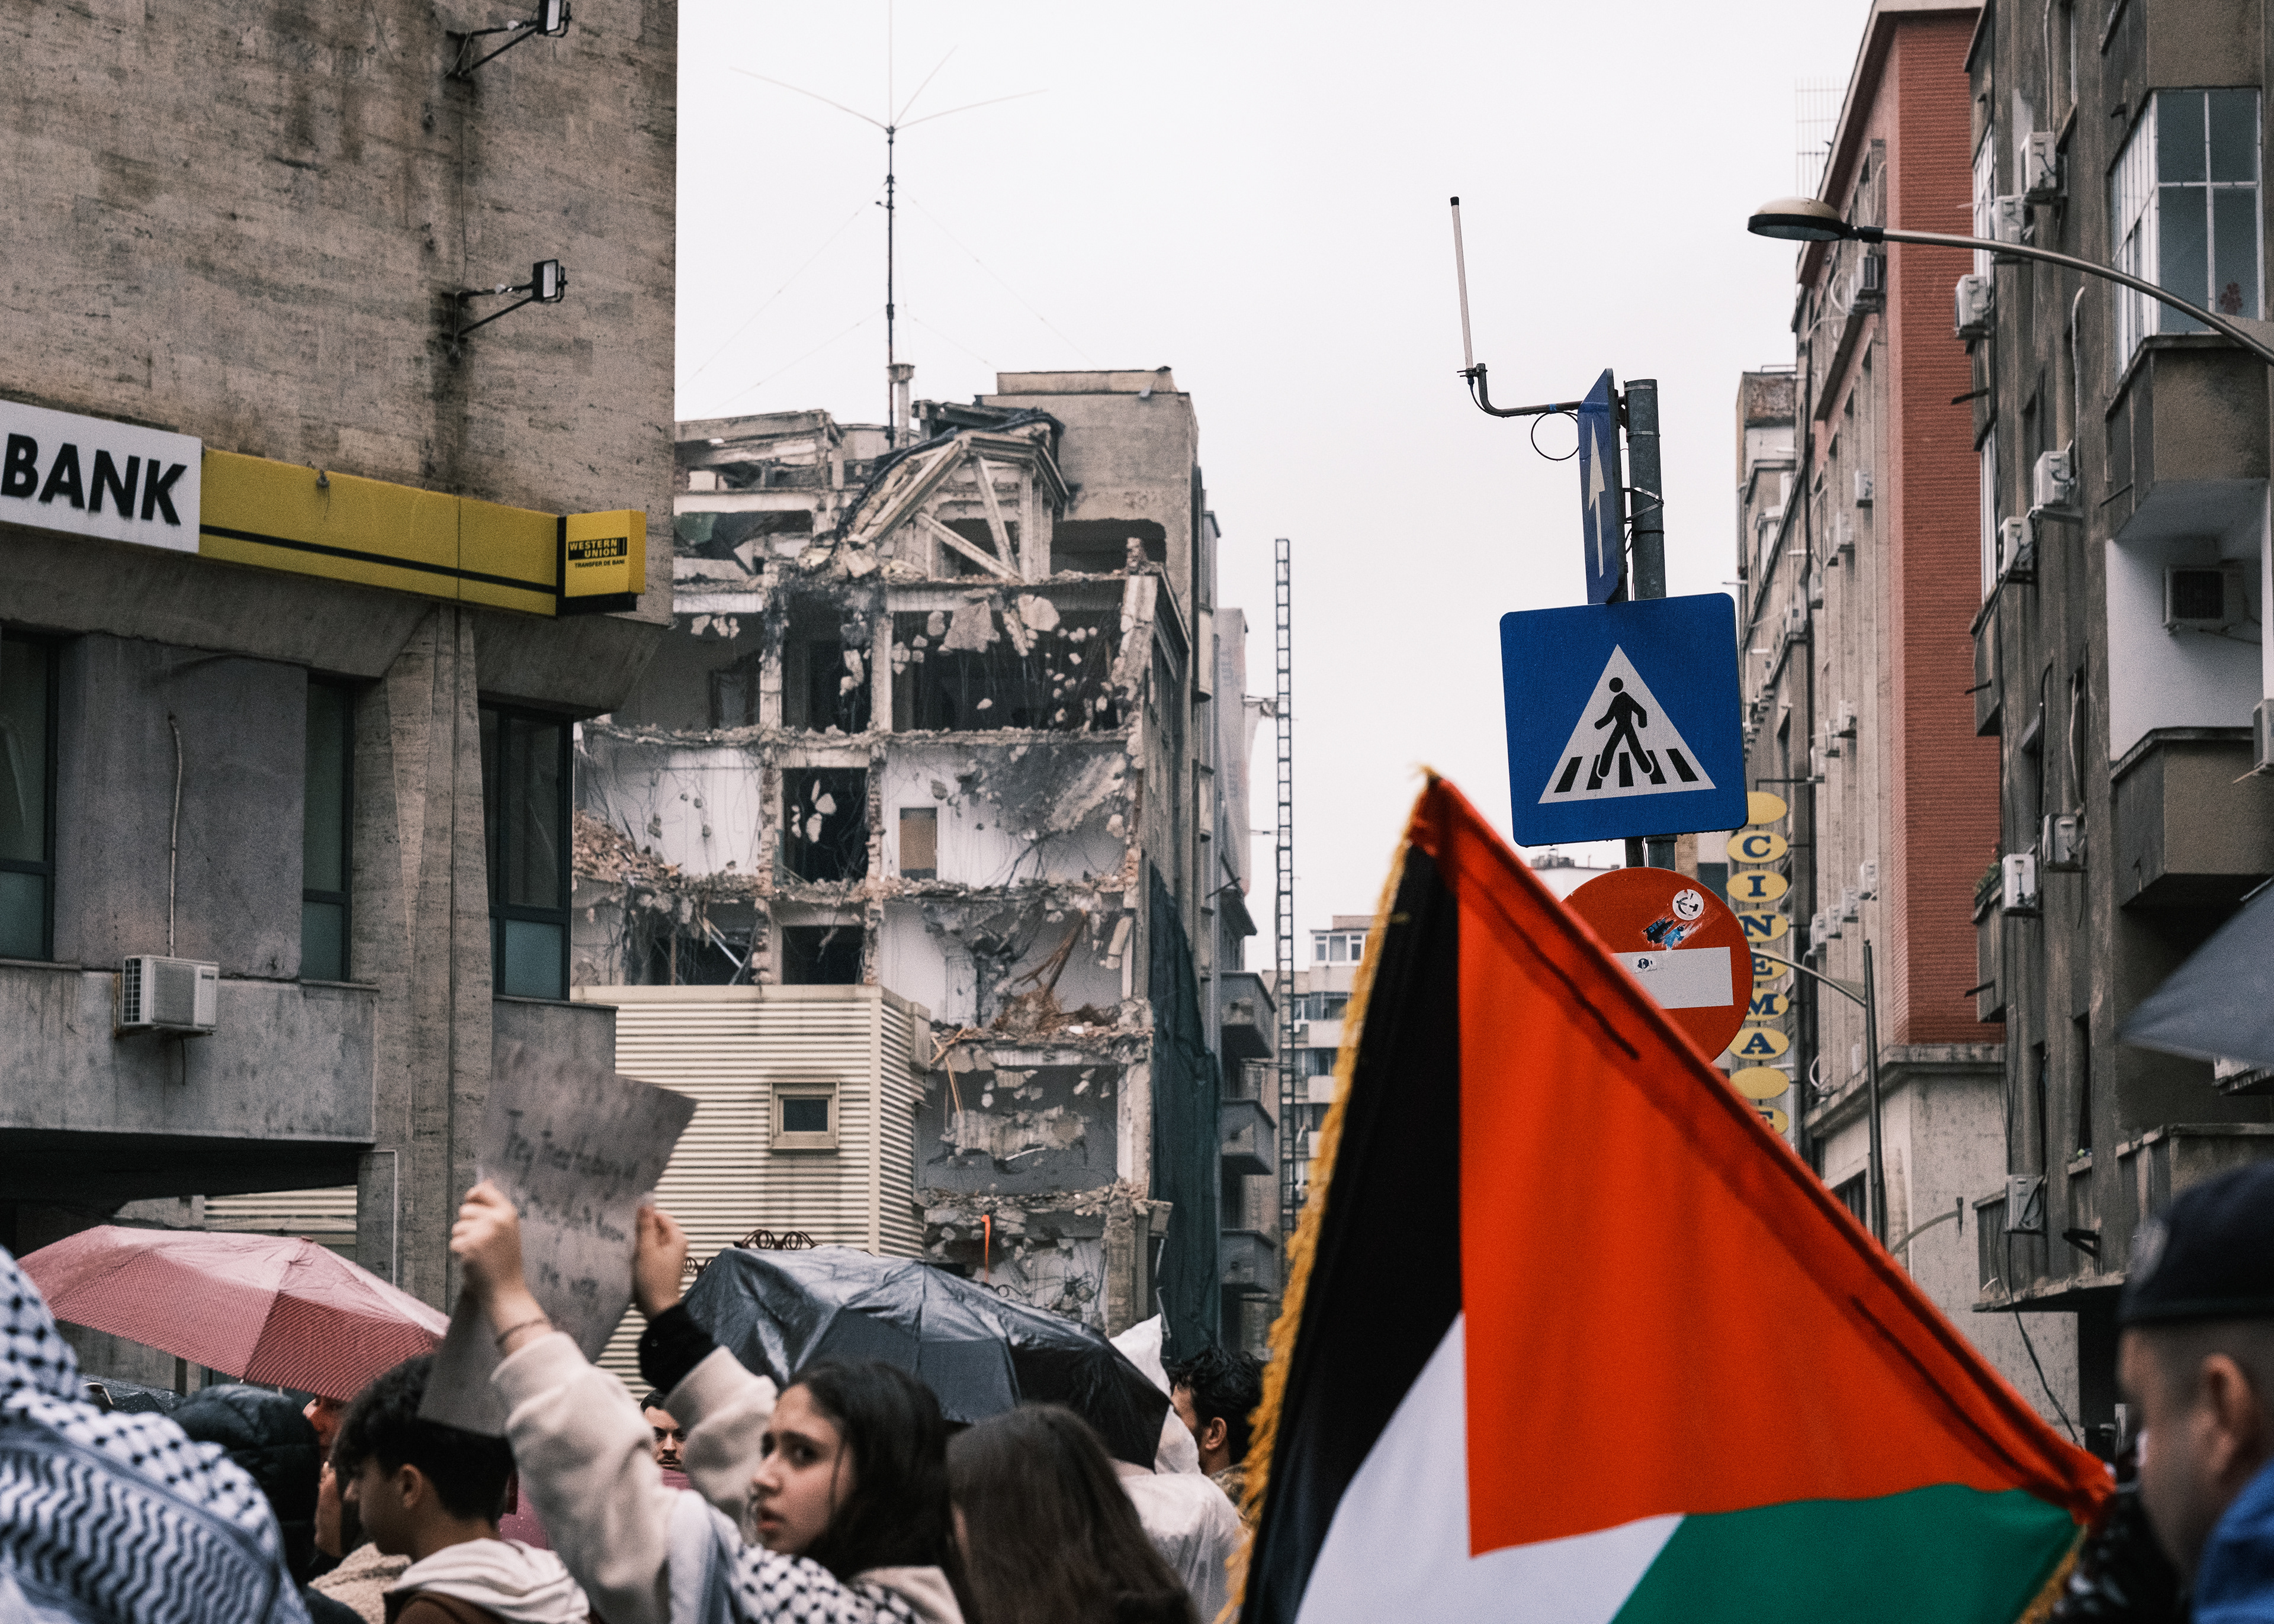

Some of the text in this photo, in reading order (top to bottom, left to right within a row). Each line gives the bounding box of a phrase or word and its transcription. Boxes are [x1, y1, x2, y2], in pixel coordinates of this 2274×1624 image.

[1, 433, 187, 525] BANK
[570, 539, 617, 551] WESTERN
[584, 548, 617, 558] UNION
[1739, 836, 1778, 1054] CINEMA
